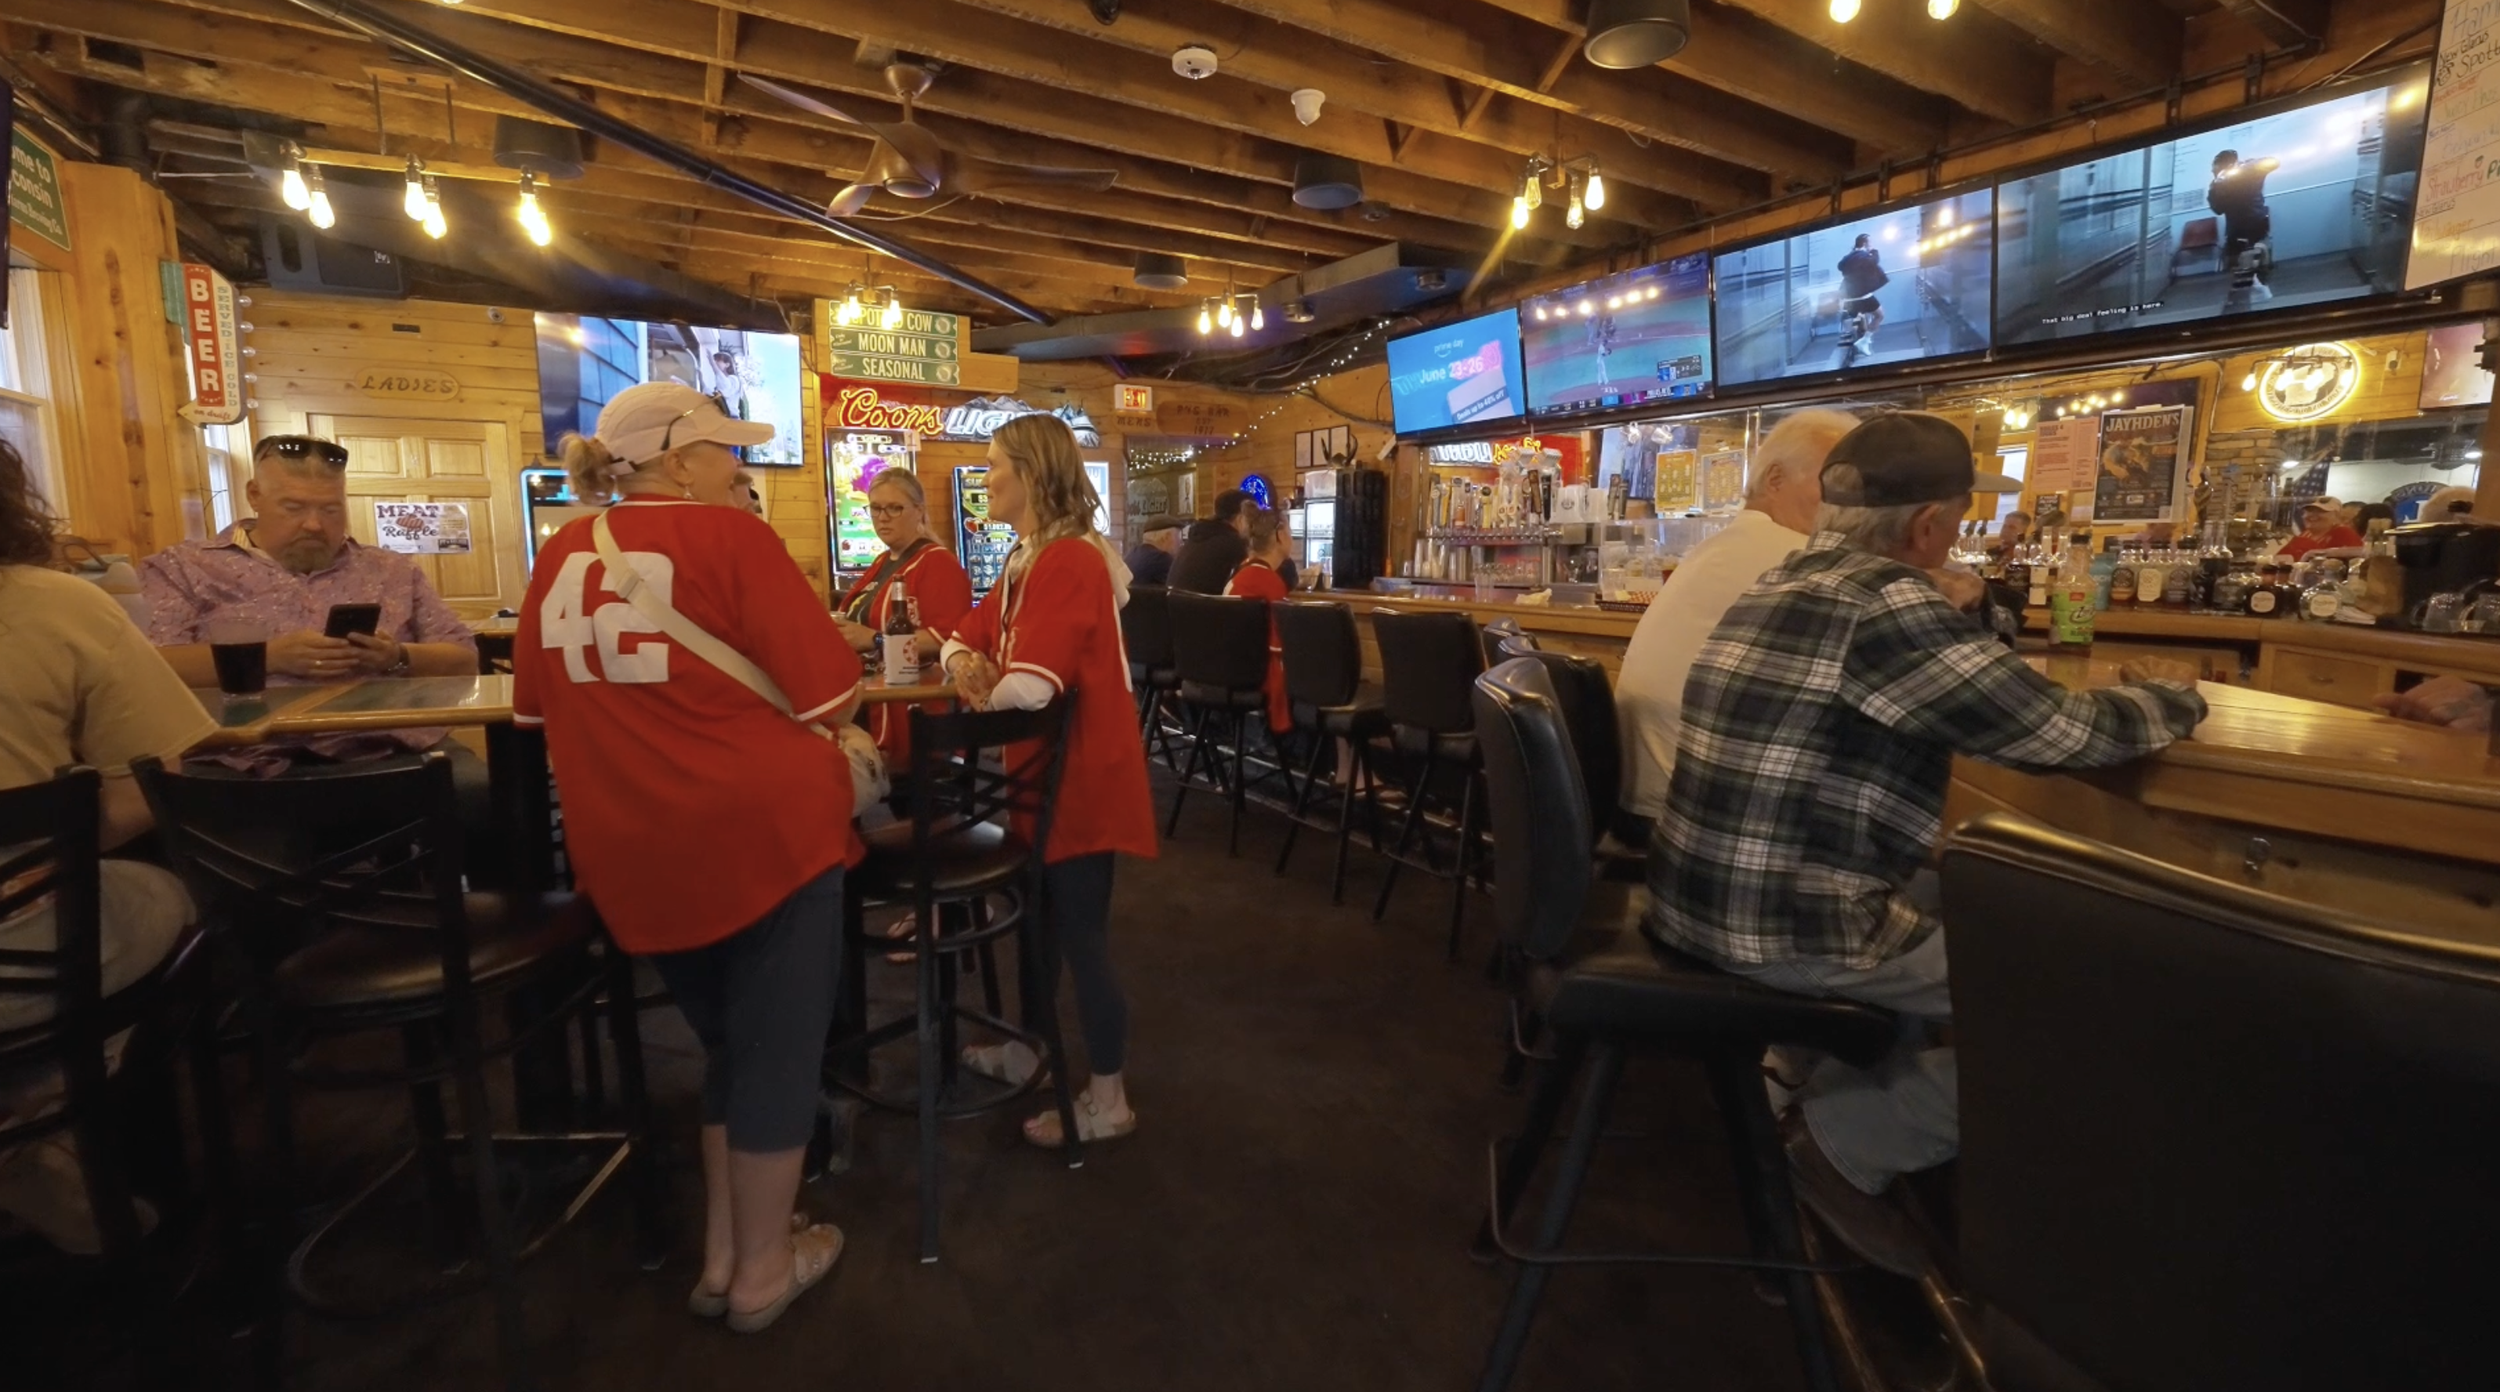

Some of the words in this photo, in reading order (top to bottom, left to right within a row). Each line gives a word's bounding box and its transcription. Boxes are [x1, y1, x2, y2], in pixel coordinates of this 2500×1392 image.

[2456, 38, 2500, 78] Spott
[11, 168, 53, 209] consin
[2425, 165, 2485, 202] Strawberry
[852, 308, 904, 331] SPOTD
[906, 312, 933, 333] COW
[2077, 311, 2093, 319] deal
[2097, 306, 2127, 317] feeling
[189, 278, 220, 392] BEER
[217, 286, 232, 338] SERVED
[226, 374, 238, 407] COLD
[858, 332, 895, 354] MOON
[899, 337, 927, 357] MAN
[862, 357, 926, 381] SEASONAL
[1420, 366, 1446, 384] June
[1447, 355, 1483, 379] 23-26
[361, 375, 454, 394] LADIES
[1124, 387, 1147, 408] EXIT
[838, 387, 944, 436] Coors
[945, 408, 1024, 436] LIG
[1116, 416, 1151, 427] MENS
[2105, 412, 2180, 433] JAYHDEN'S
[376, 504, 439, 519] MEAT
[382, 525, 438, 541] Raffle
[540, 551, 674, 684] 42
